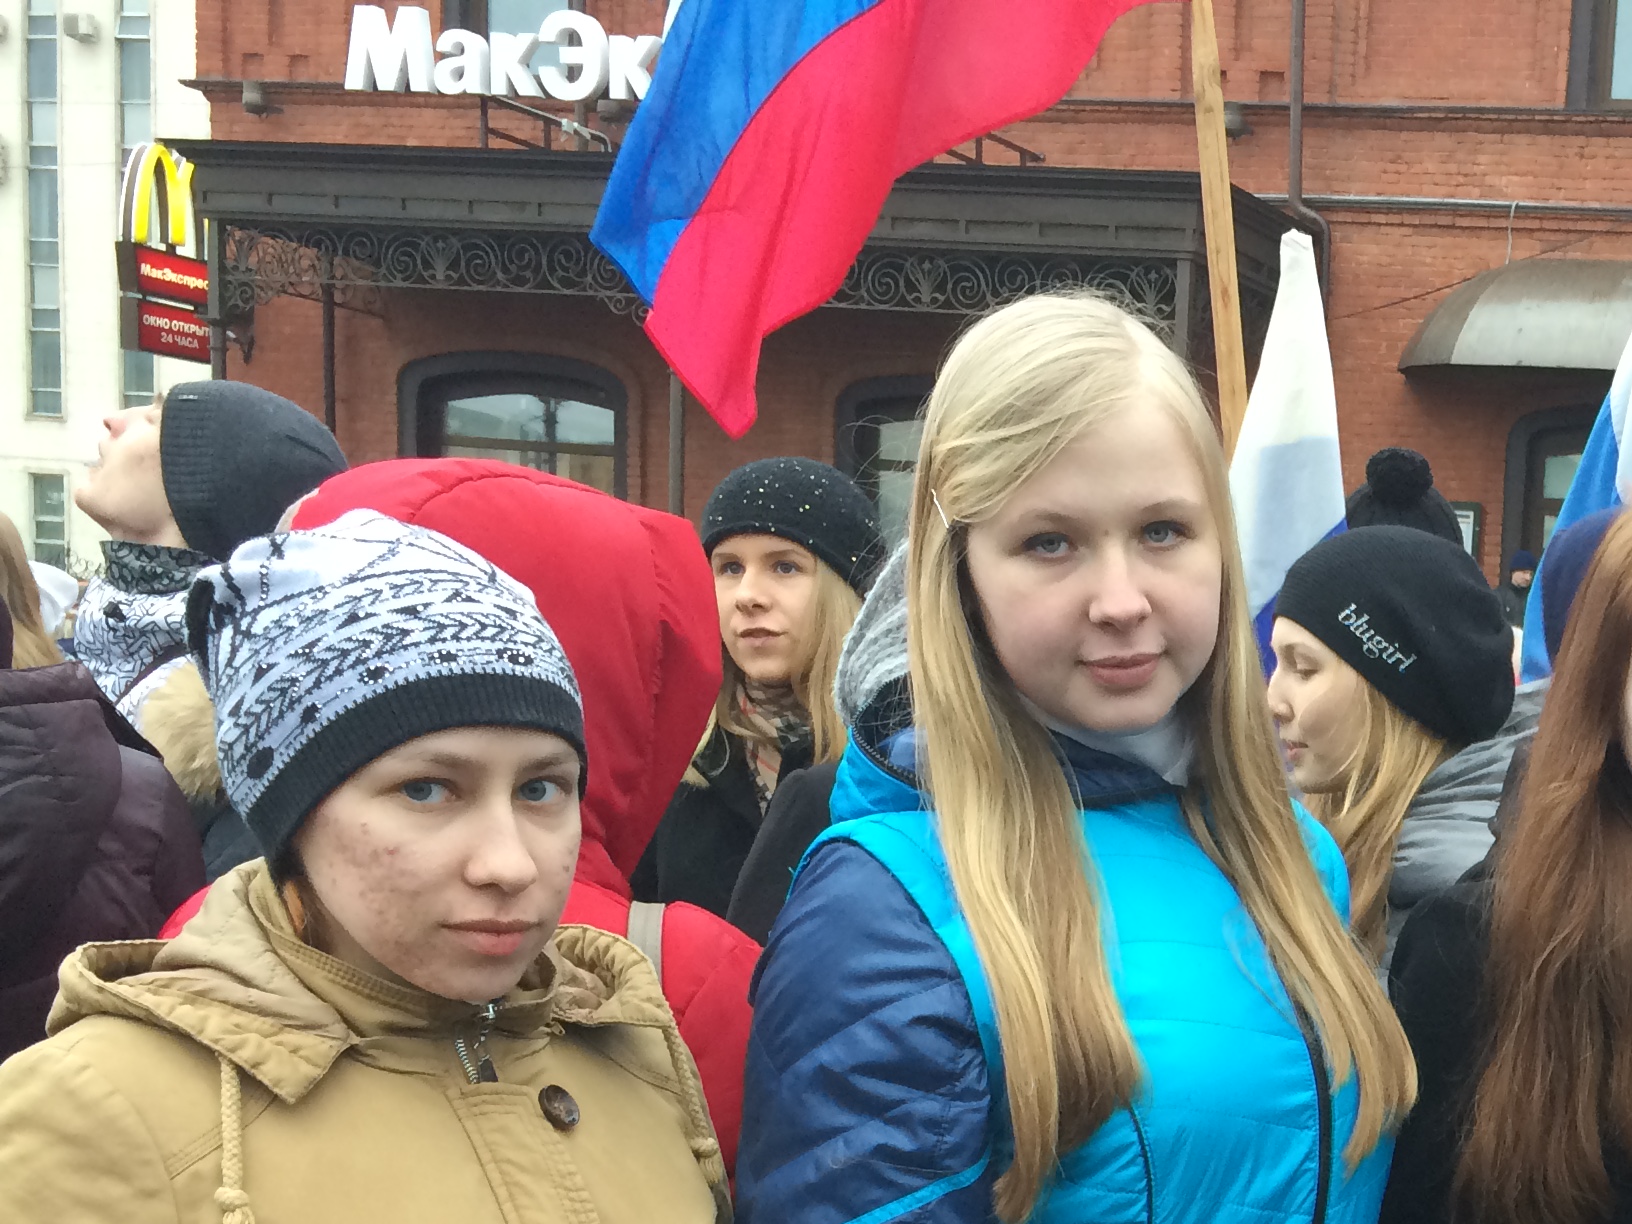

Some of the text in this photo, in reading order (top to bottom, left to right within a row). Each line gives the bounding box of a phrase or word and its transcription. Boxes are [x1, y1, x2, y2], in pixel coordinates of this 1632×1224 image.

[142, 314, 170, 330] ОКНО
[160, 331, 199, 349] 24 ЧАСА
[1337, 603, 1418, 674] blugirl
